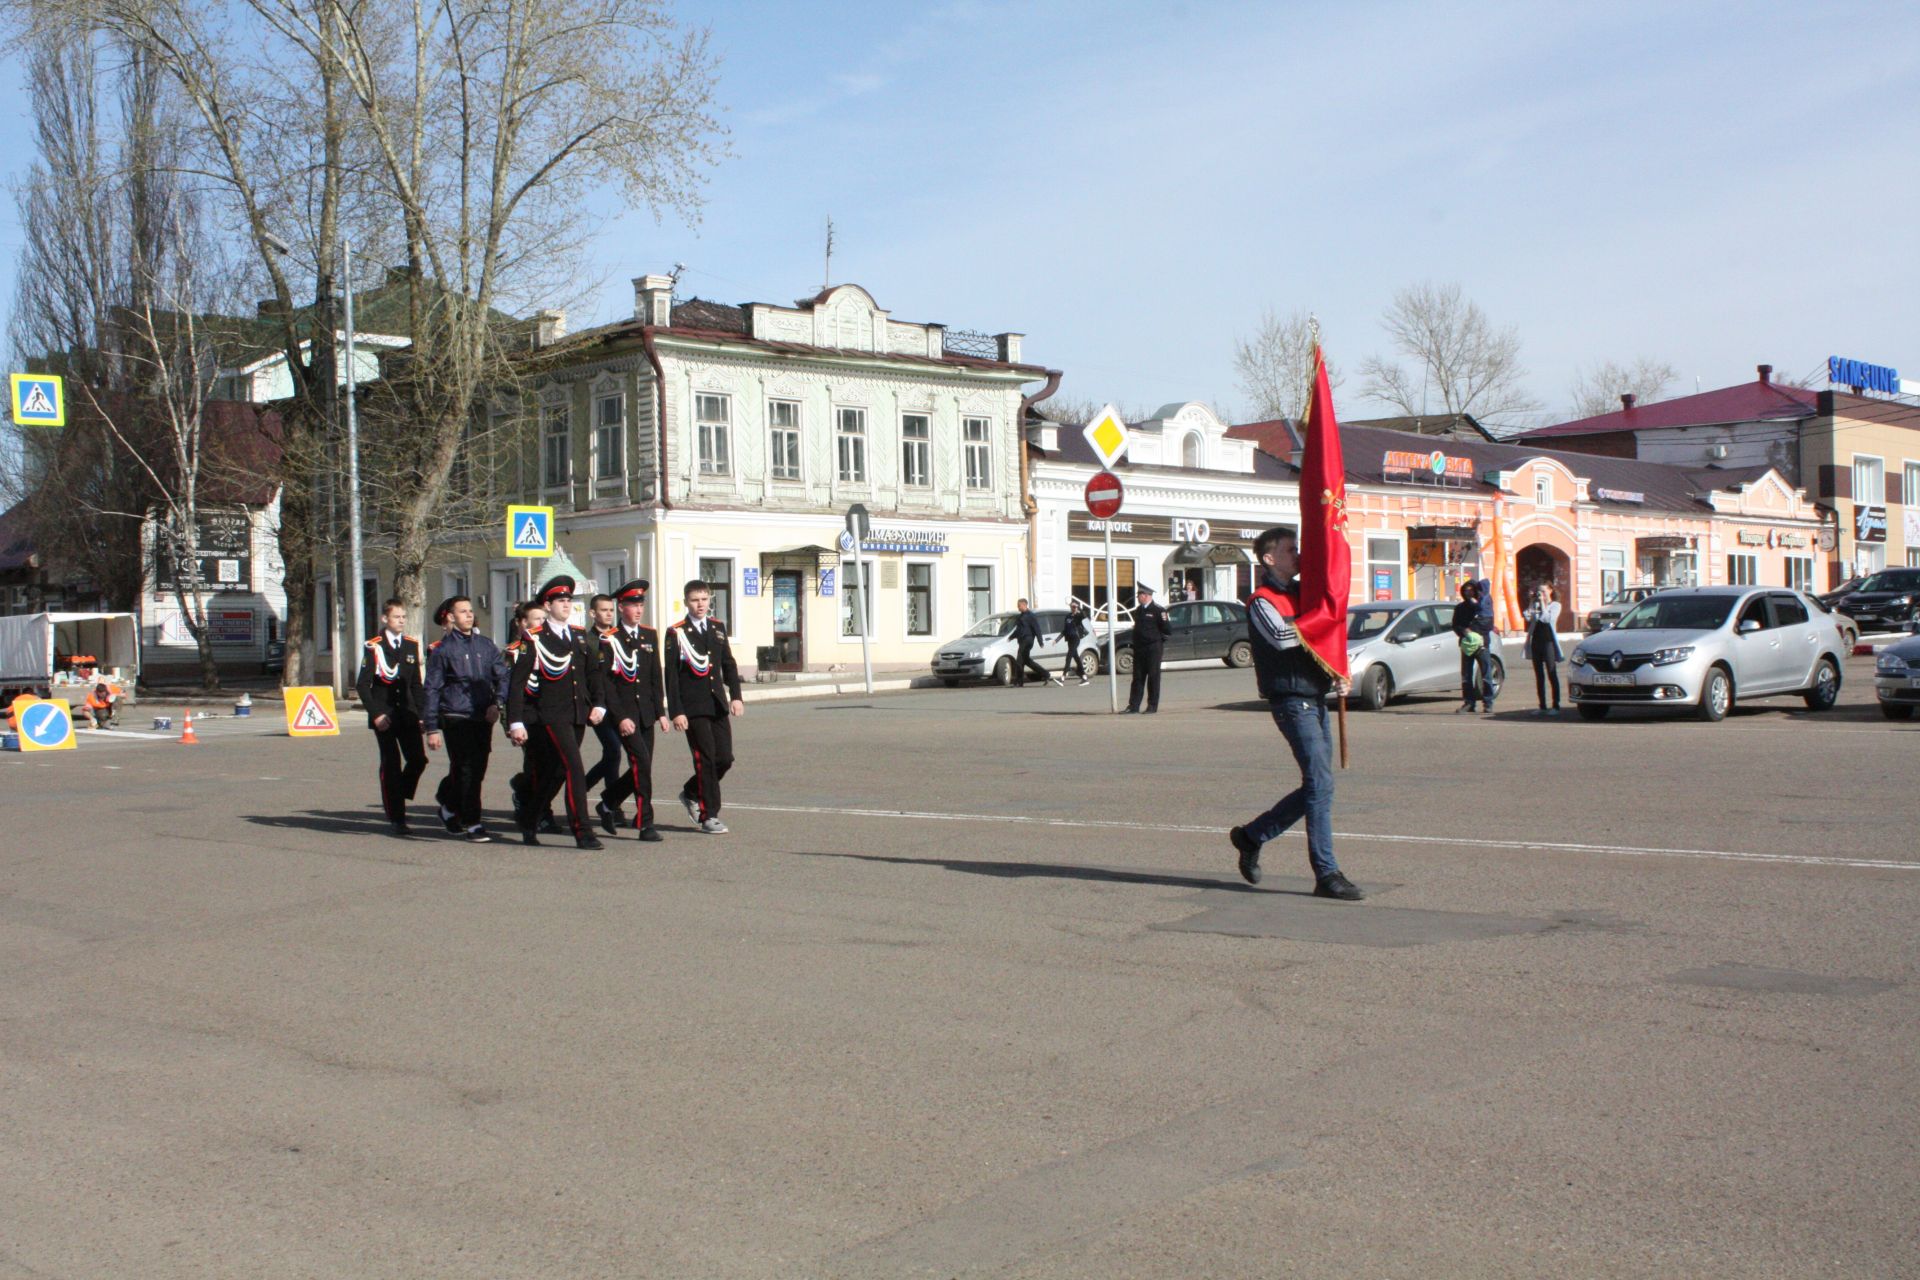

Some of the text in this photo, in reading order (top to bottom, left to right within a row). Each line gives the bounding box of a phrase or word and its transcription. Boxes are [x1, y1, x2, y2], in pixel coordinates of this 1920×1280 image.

[1829, 355, 1901, 395] SAMSUNG
[1383, 450, 1473, 473] АПТЕКА ВИТА
[1171, 518, 1211, 544] EVO
[1240, 528, 1265, 539] LOU
[862, 543, 920, 552] ювелирная
